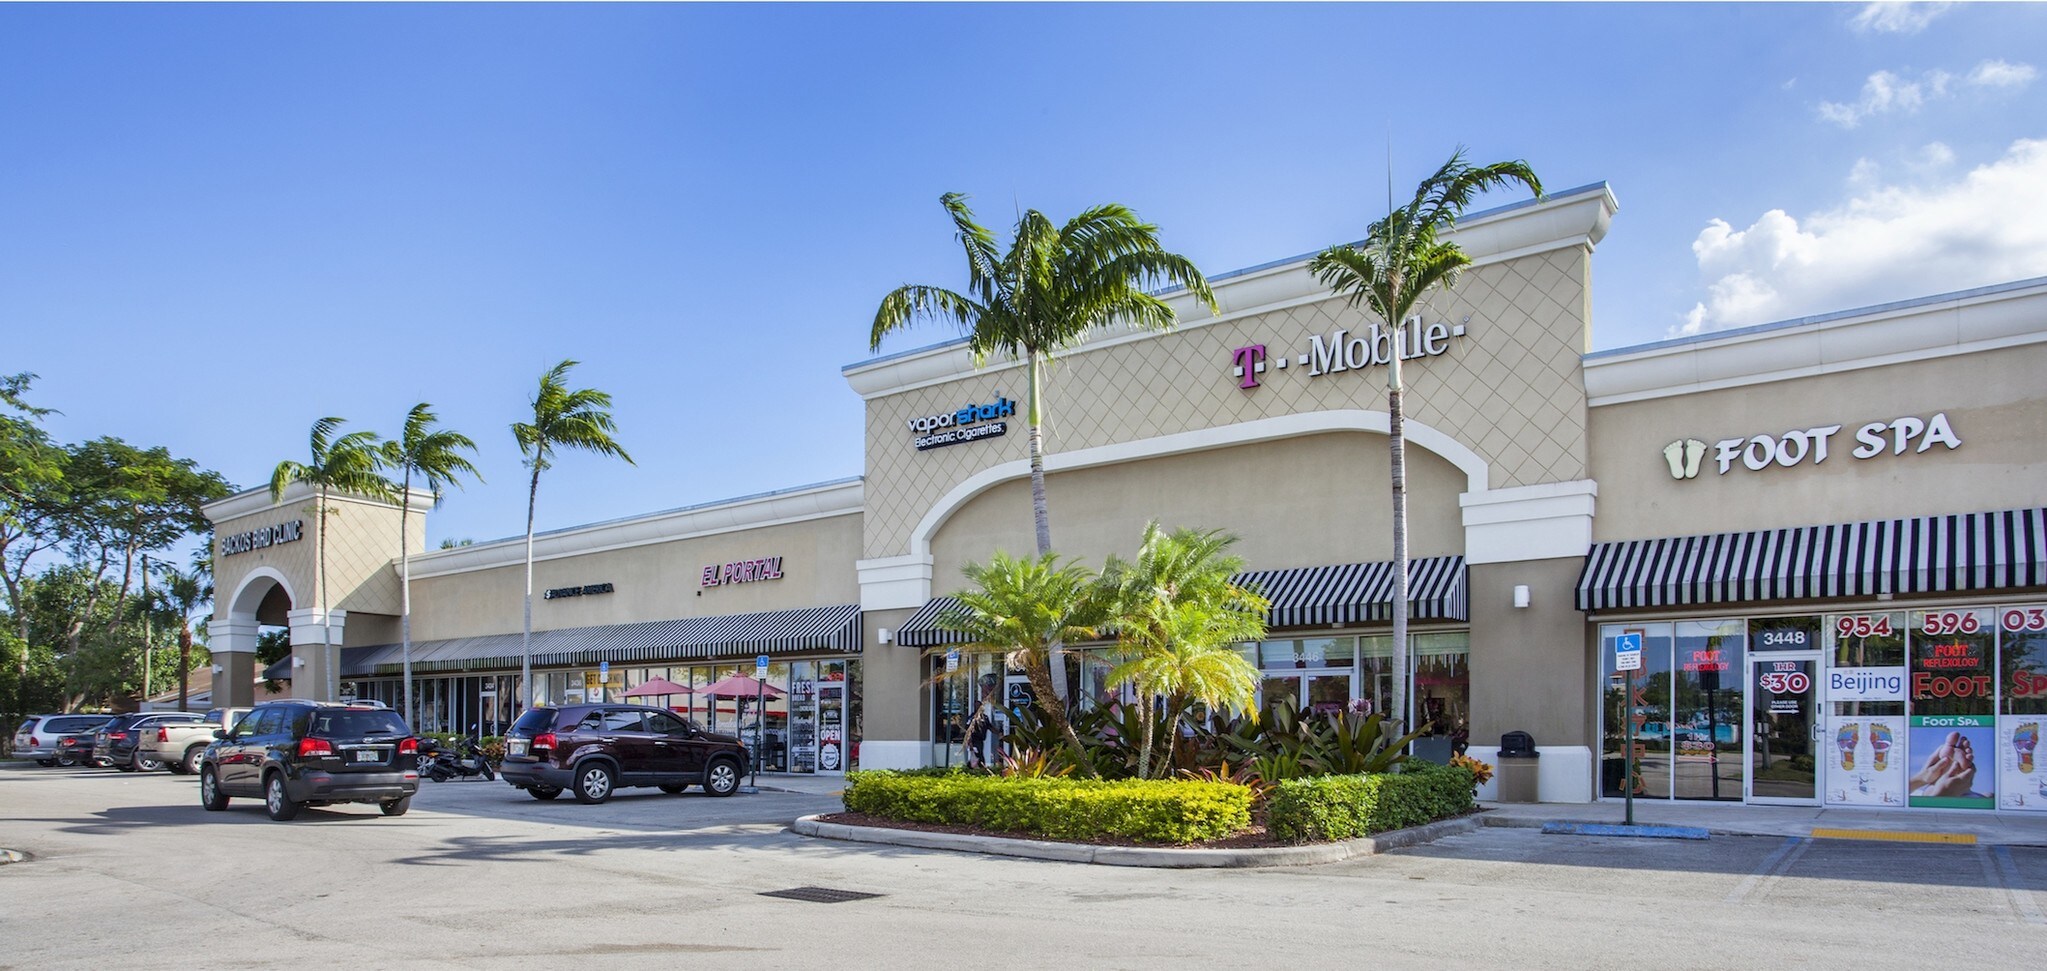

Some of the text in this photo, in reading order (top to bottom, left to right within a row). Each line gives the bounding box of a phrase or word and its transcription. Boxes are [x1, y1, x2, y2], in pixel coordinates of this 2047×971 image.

[914, 430, 956, 449] Electronic
[1714, 412, 1962, 475] FOOT SPA
[252, 526, 273, 550] BIRD
[272, 519, 303, 545] CLINIC
[701, 556, 784, 588] EL PORTAL
[1838, 615, 1892, 638] 954
[1922, 611, 1980, 635] 596
[1763, 631, 1806, 646] 3448
[1292, 652, 1319, 663] 3446
[1692, 650, 1721, 662] FOOT
[1934, 644, 1969, 658] FOOT
[1923, 657, 1979, 668] REFLEXOLOGY
[792, 681, 816, 694] FRESH
[1759, 672, 1810, 694] $30
[1831, 672, 1901, 694] Beijing
[820, 729, 841, 741] OPEN
